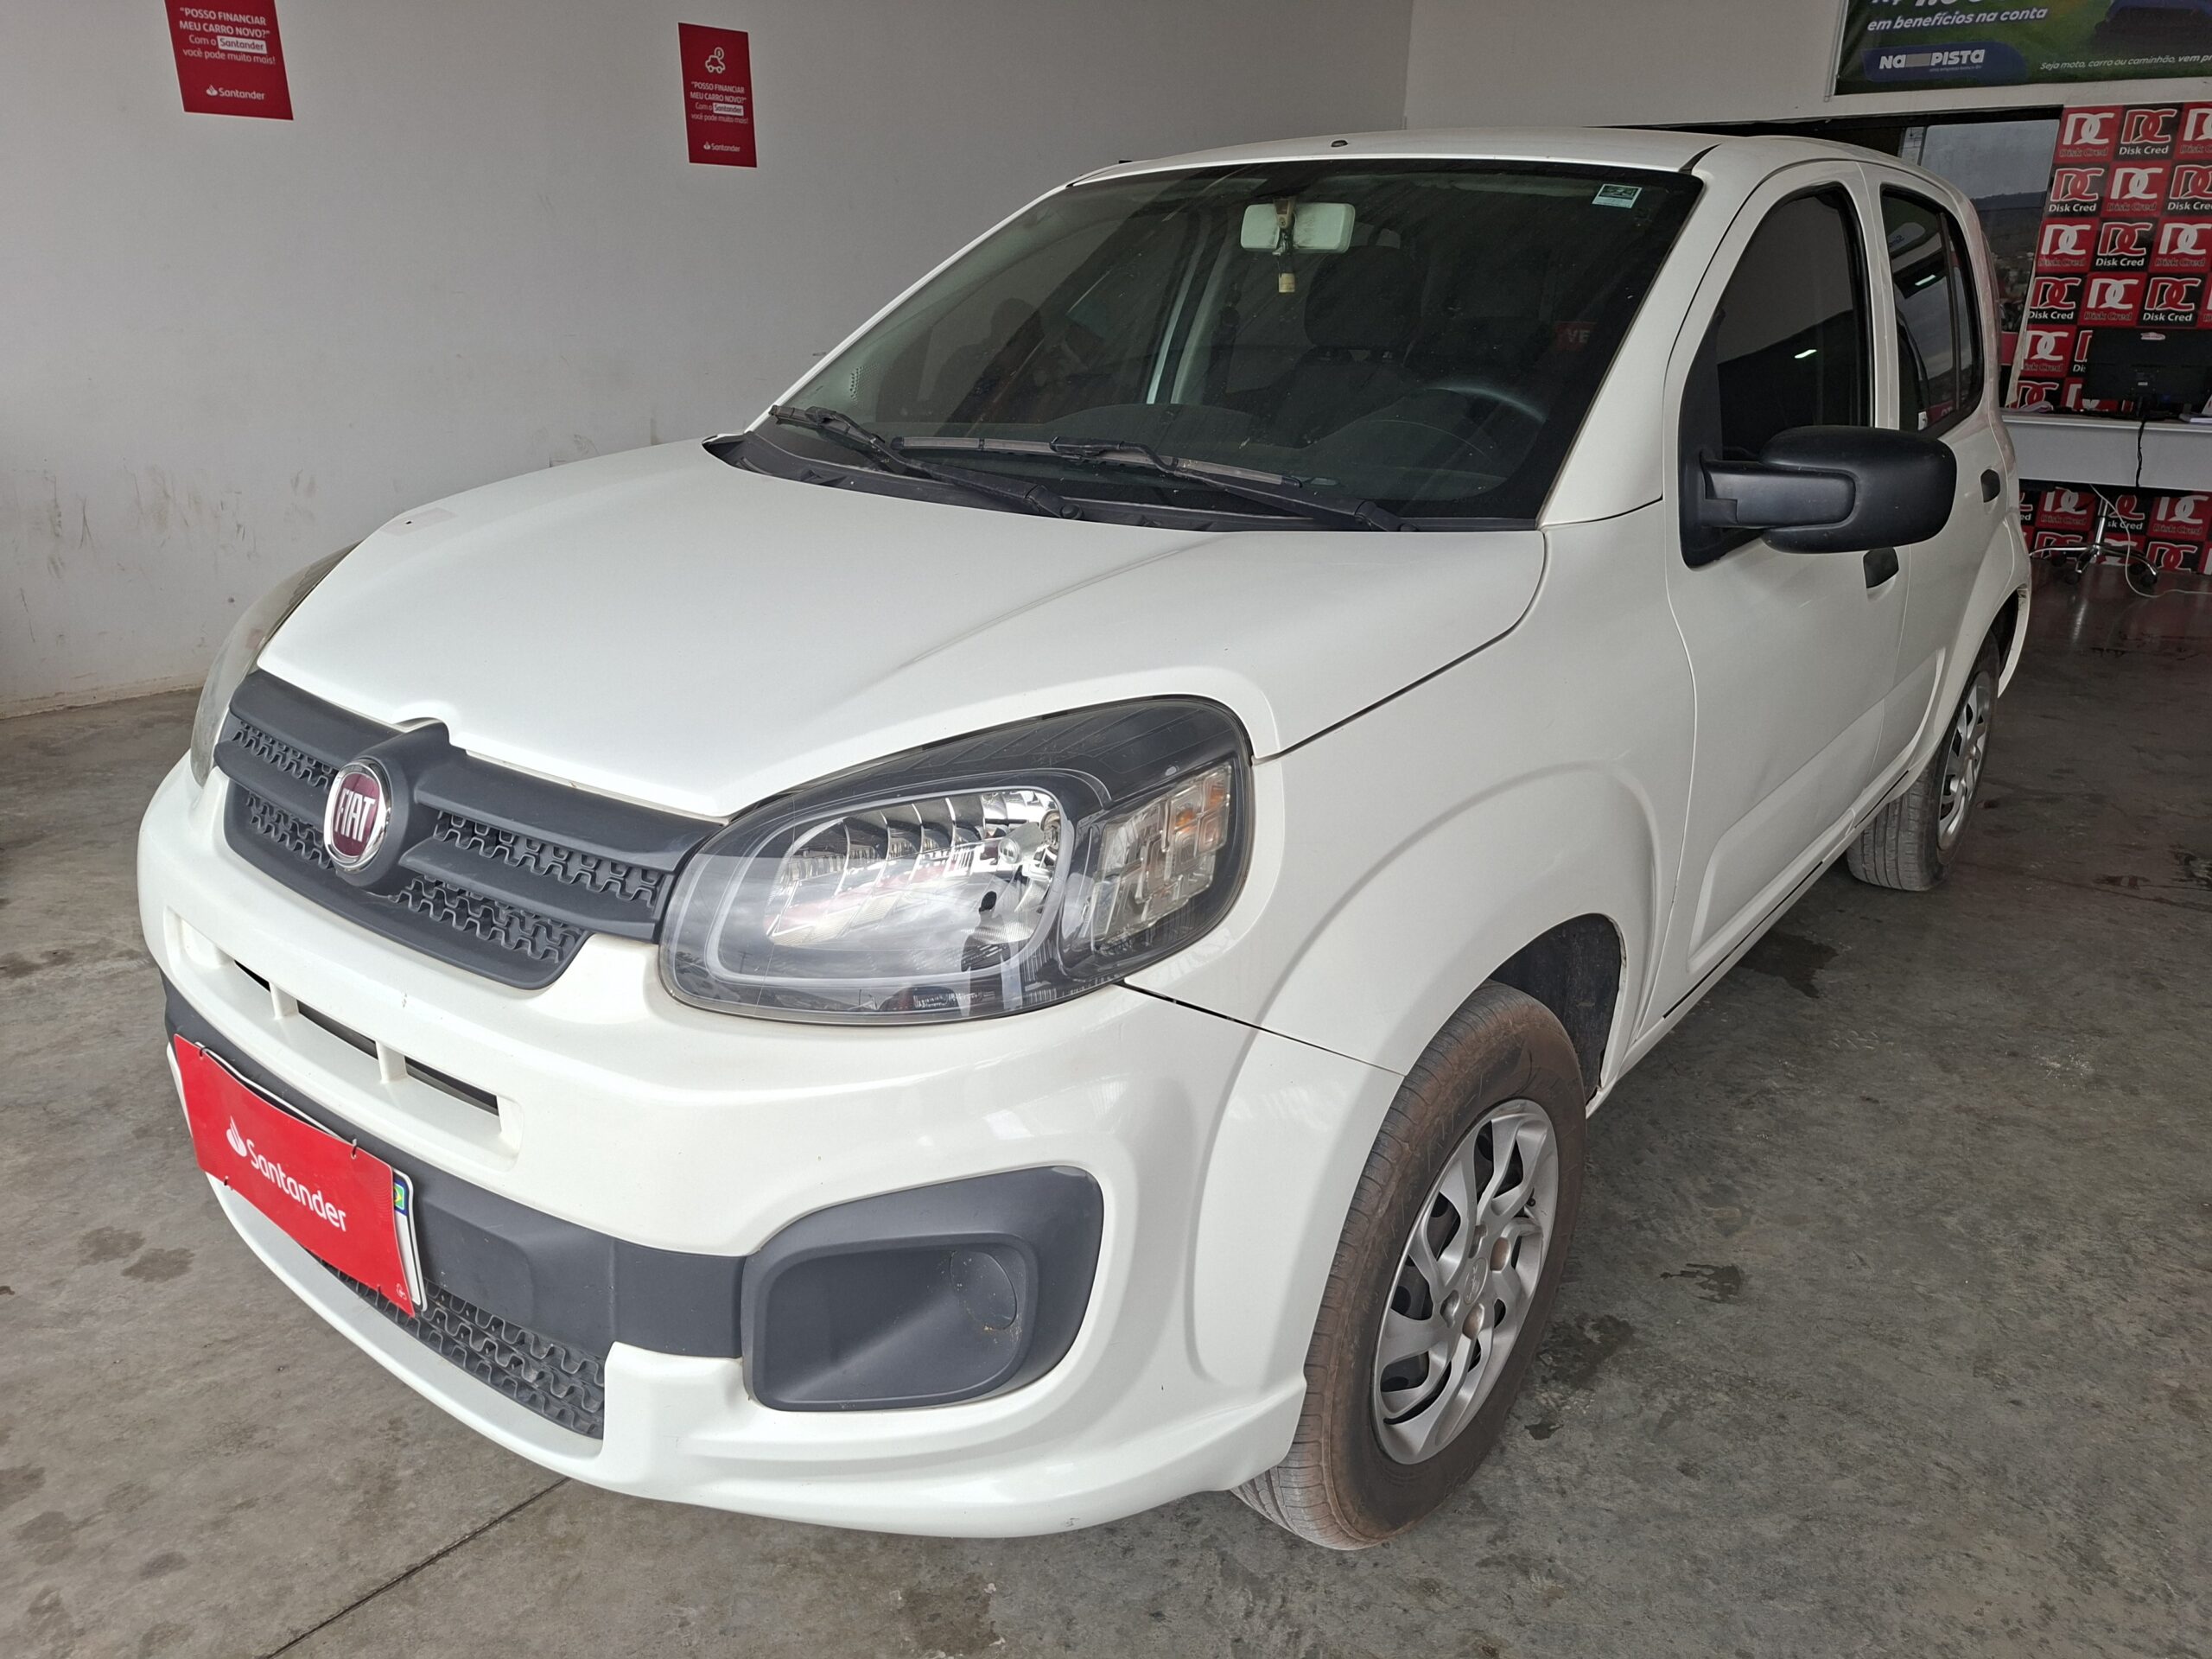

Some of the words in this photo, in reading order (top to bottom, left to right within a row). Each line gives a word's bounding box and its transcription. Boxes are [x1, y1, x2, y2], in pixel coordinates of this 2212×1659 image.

[218, 11, 266, 26] FINANCIAR
[1867, 19, 1891, 31] em
[1893, 10, 1974, 30] benefícios
[1975, 12, 1998, 23] na
[1999, 7, 2049, 21] conta
[180, 21, 201, 31] MEU
[202, 22, 233, 35] CARRO
[188, 35, 209, 46] Com
[219, 38, 264, 51] Santander
[182, 48, 203, 58] você
[204, 50, 226, 60] pode
[227, 52, 252, 62] muito
[253, 55, 276, 65] mais!
[2040, 61, 2061, 72] Seja
[2178, 54, 2201, 63] vem
[715, 83, 745, 93] FINANCIAR
[219, 87, 265, 101] Santander
[704, 92, 724, 102] CARRO
[696, 102, 709, 111] Com
[714, 104, 743, 114] Santander
[704, 114, 718, 123] pode
[711, 143, 741, 153] Santander
[2119, 145, 2142, 155] Disk
[2144, 145, 2169, 155] Cred
[2049, 203, 2070, 213] Disk
[2073, 202, 2096, 213] Cred
[2168, 201, 2190, 211] Disk
[2095, 257, 2118, 266] Disk
[2120, 257, 2145, 266] Cred
[2028, 310, 2049, 320] Disk
[2050, 310, 2074, 320] Cred
[2142, 312, 2165, 321] Disk
[2167, 312, 2193, 321] Cred
[334, 787, 376, 842] FIAT
[245, 1139, 346, 1232] Santander
